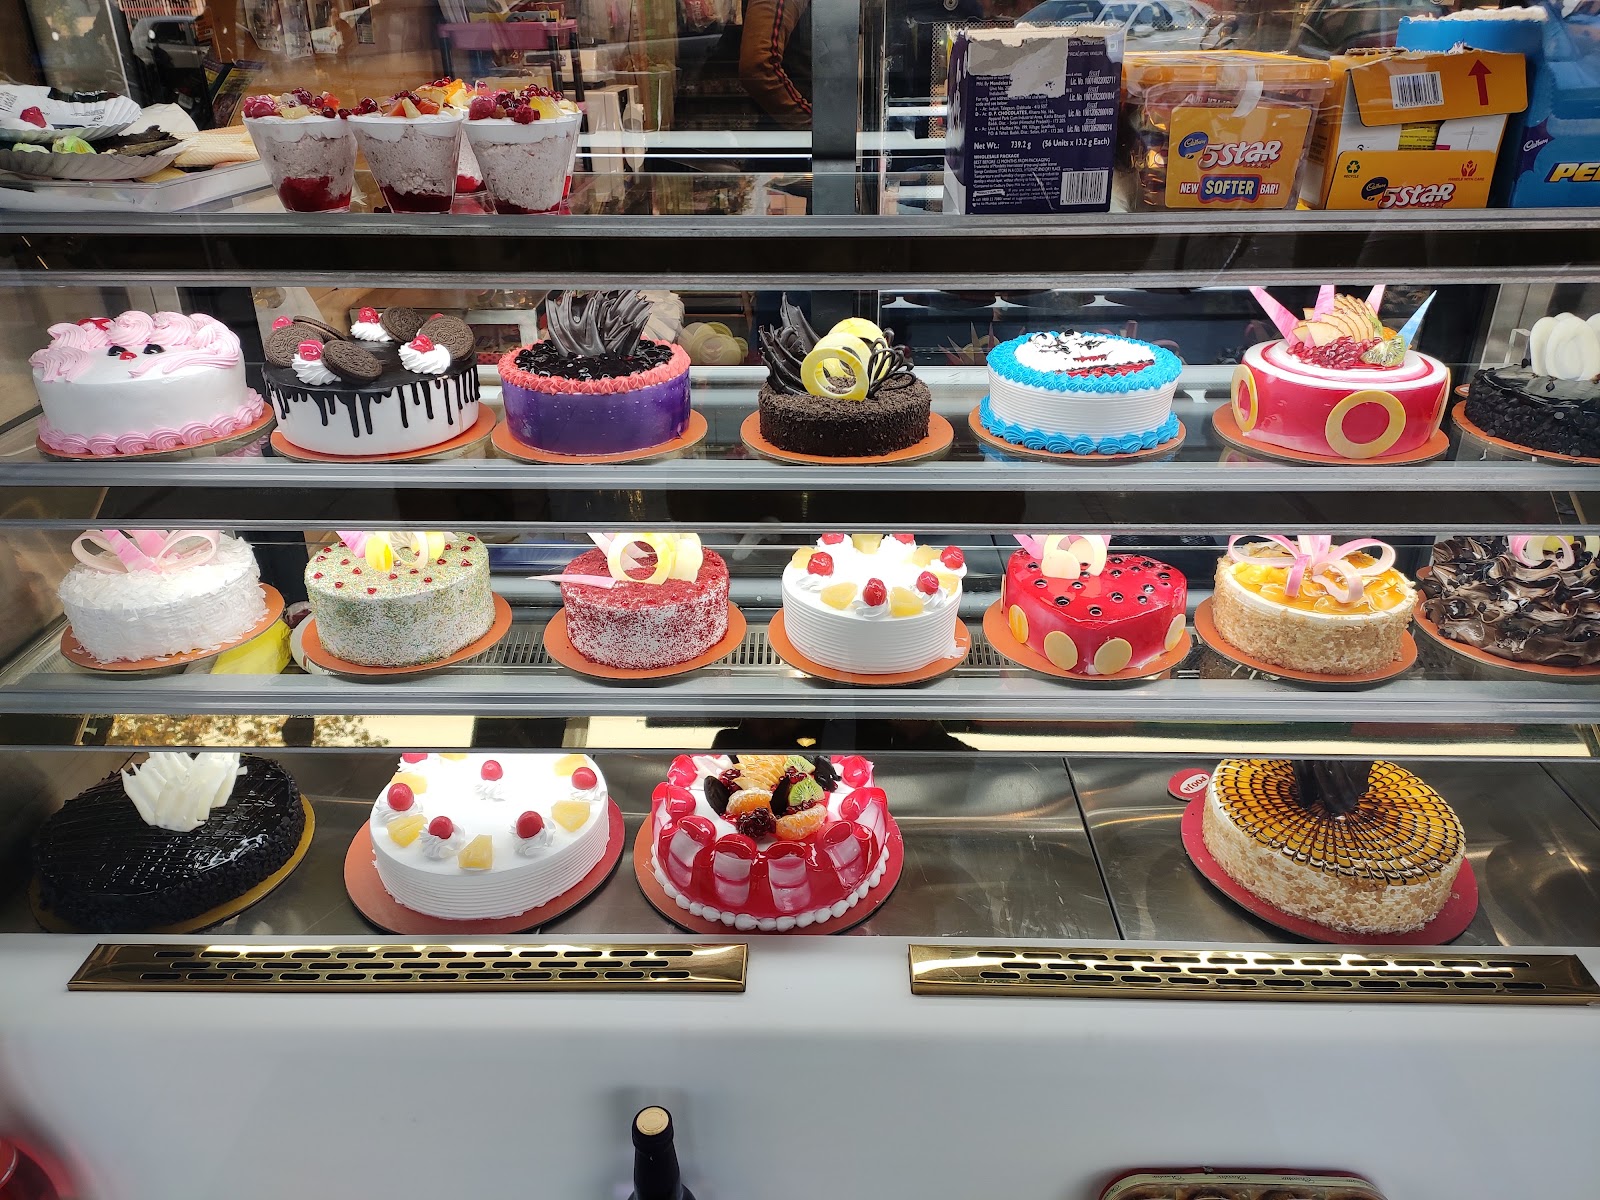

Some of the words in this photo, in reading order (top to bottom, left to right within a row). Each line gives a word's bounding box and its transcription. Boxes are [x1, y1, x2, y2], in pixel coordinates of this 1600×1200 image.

[974, 142, 985, 150] Net
[1027, 142, 1031, 150] g
[1042, 140, 1052, 148] (56
[1075, 138, 1087, 146] 13.2
[1088, 139, 1092, 147] g
[1094, 137, 1110, 145] Each)
[1187, 138, 1206, 148] Cadbury
[1523, 137, 1548, 151] Cadbury
[1180, 184, 1200, 193] NEW
[1205, 180, 1254, 195] SOFTER
[1260, 184, 1279, 194] BAR!
[1366, 182, 1386, 191] Cadbury
[1184, 776, 1207, 791] POOJA
